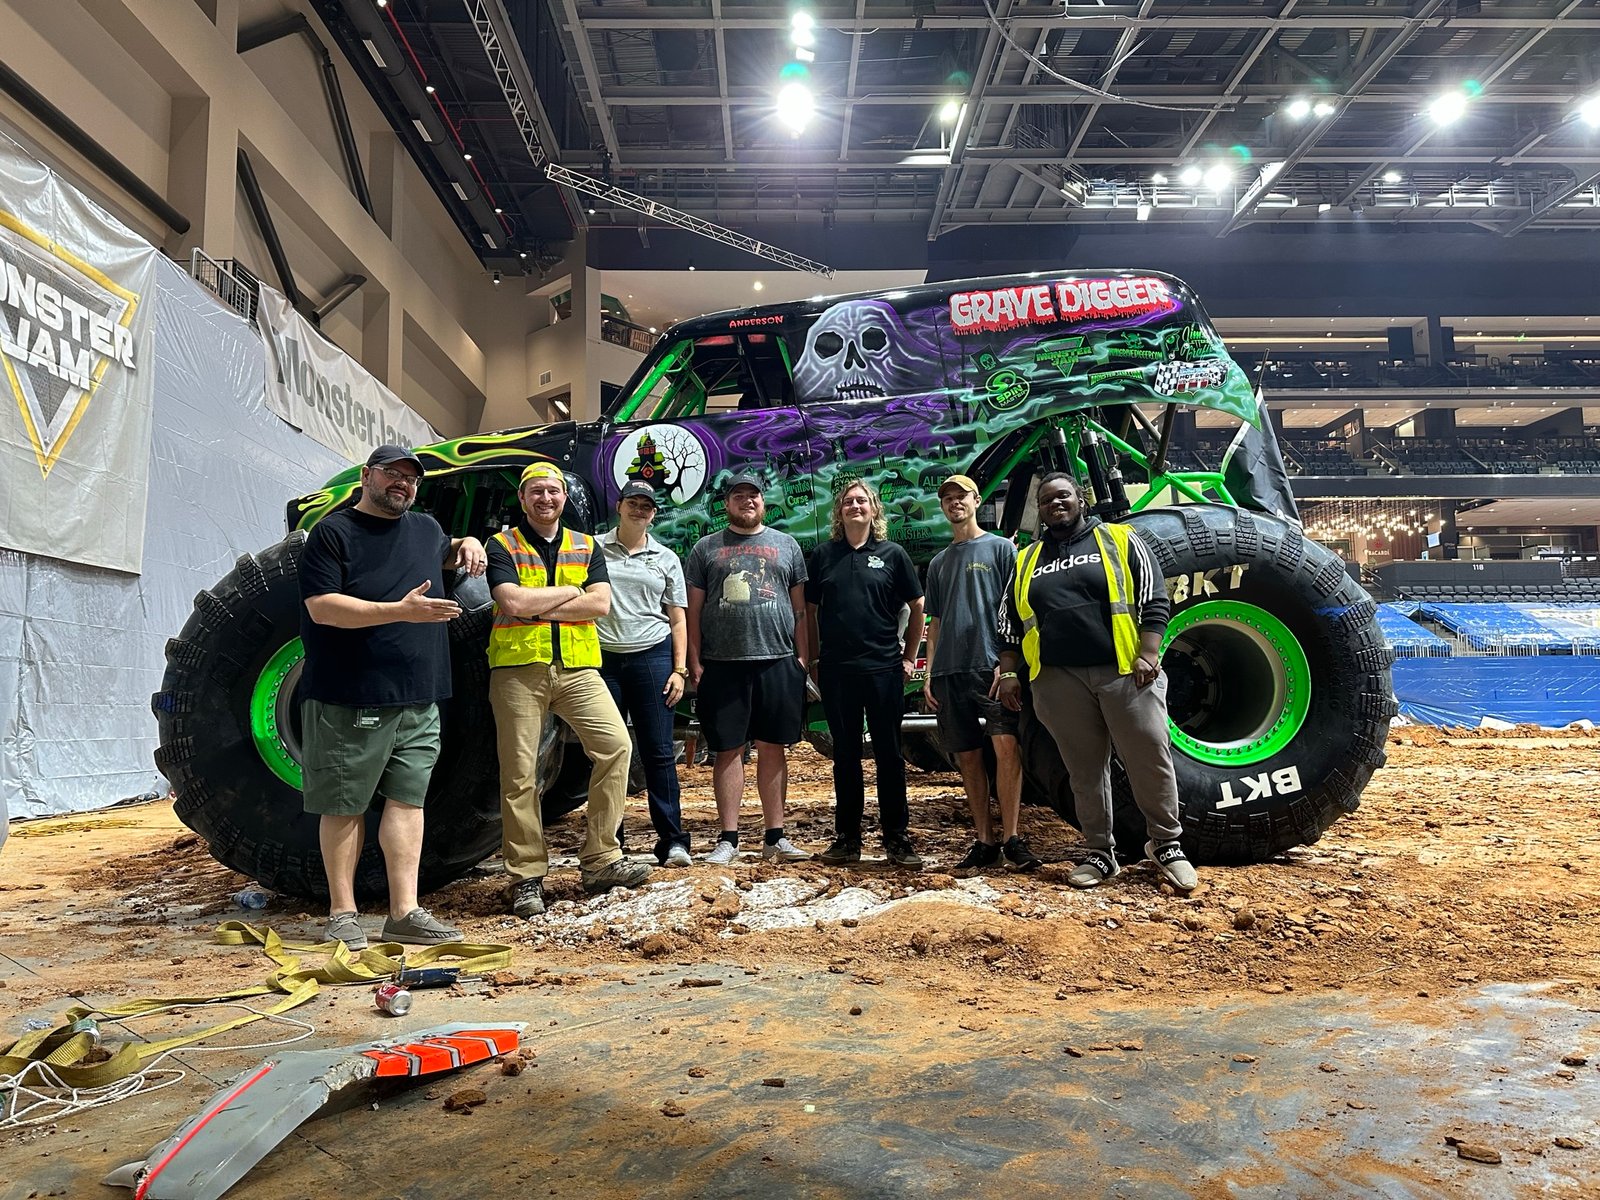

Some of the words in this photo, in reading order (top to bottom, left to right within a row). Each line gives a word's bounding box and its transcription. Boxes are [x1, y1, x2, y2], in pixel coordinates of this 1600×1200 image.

[951, 284, 1053, 327] GRAVE
[1057, 278, 1171, 312] DIGGER
[729, 315, 784, 329] ANDERSON
[1, 317, 90, 390] JAM
[1036, 346, 1093, 362] MONSTER
[1051, 355, 1080, 366] JAM
[996, 384, 1024, 404] SPIN
[833, 470, 857, 480] ADAM
[922, 475, 947, 487] ALIE
[787, 494, 809, 506] Curse
[1031, 552, 1102, 579] adidas
[1164, 563, 1250, 604] BKT
[1216, 766, 1302, 809] BKT
